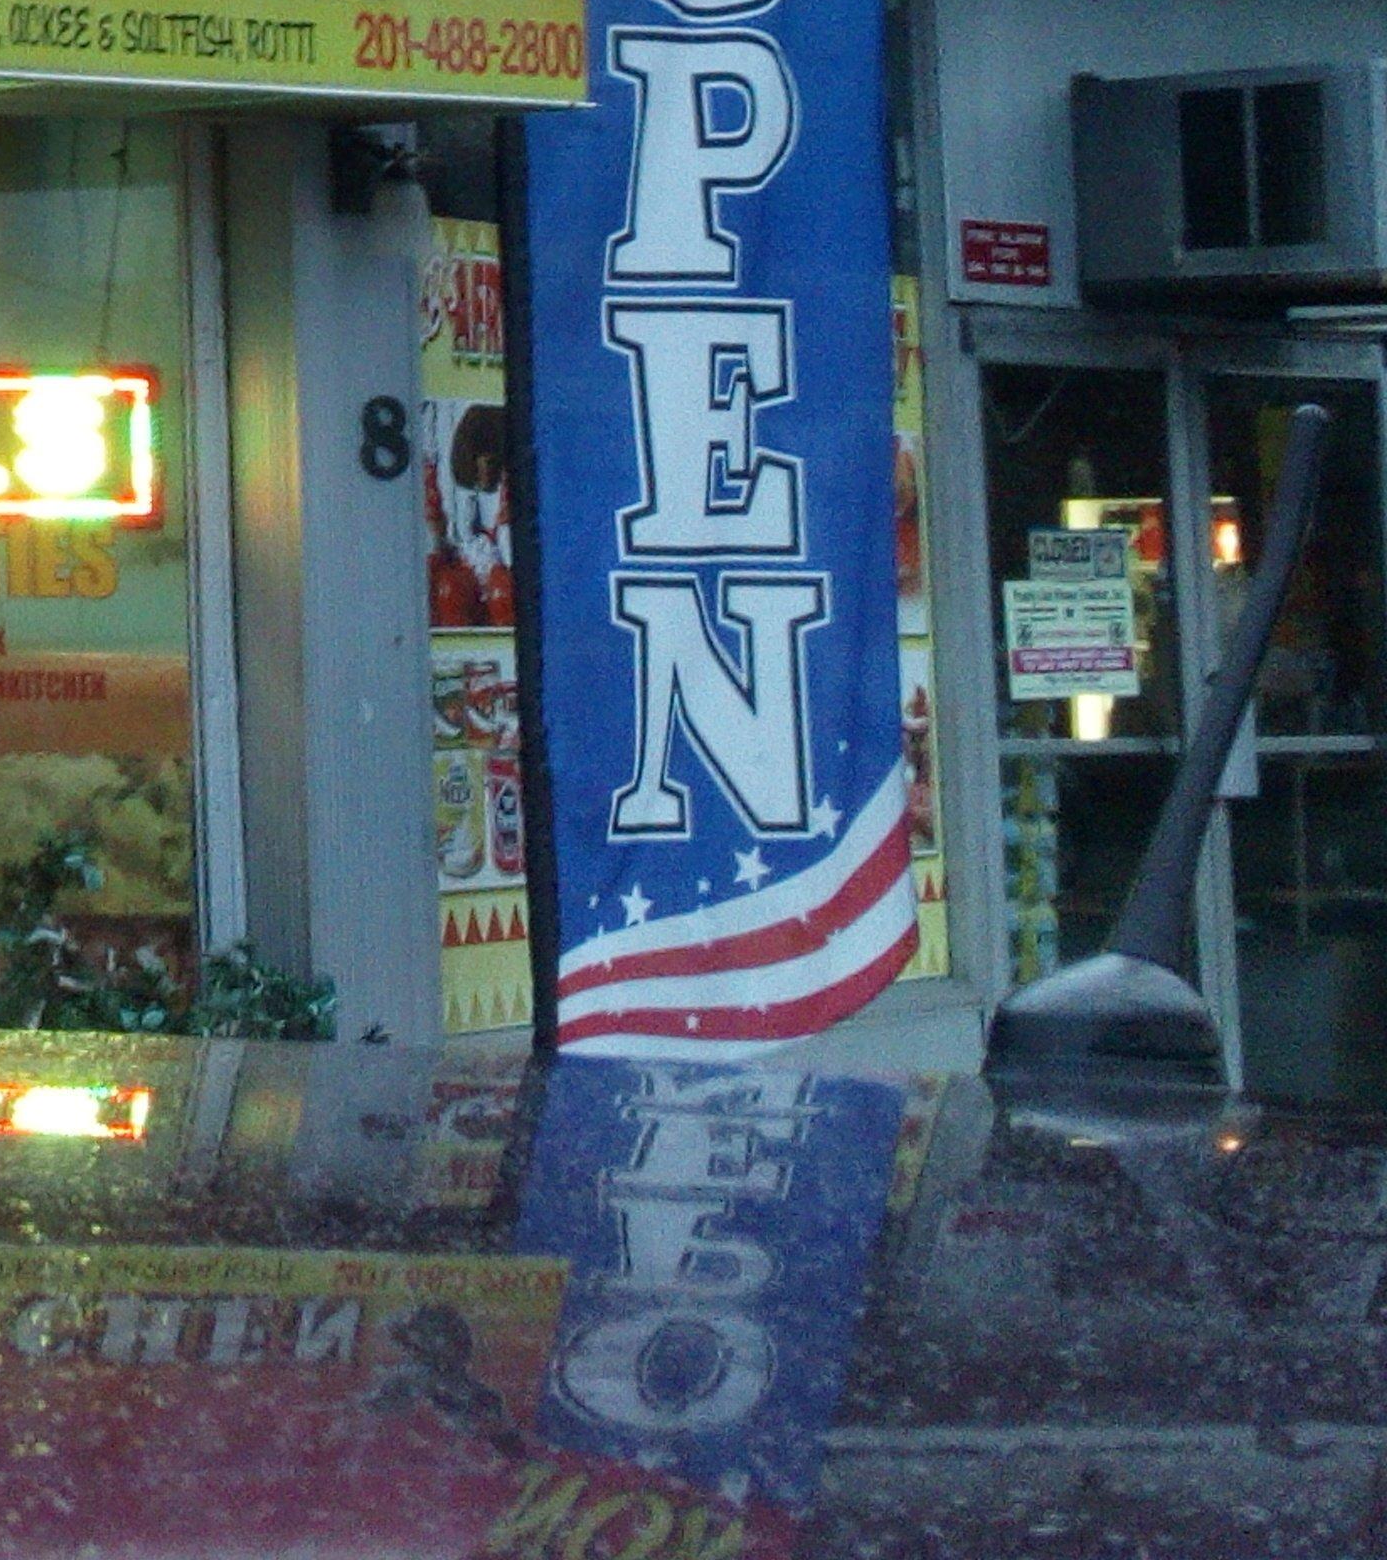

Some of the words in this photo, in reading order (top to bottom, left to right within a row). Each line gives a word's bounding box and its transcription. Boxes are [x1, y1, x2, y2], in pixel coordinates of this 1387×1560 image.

[96, 13, 114, 53] &
[244, 17, 317, 65] ROTTI
[353, 10, 584, 80] 201-488-2800
[359, 394, 411, 482] 8
